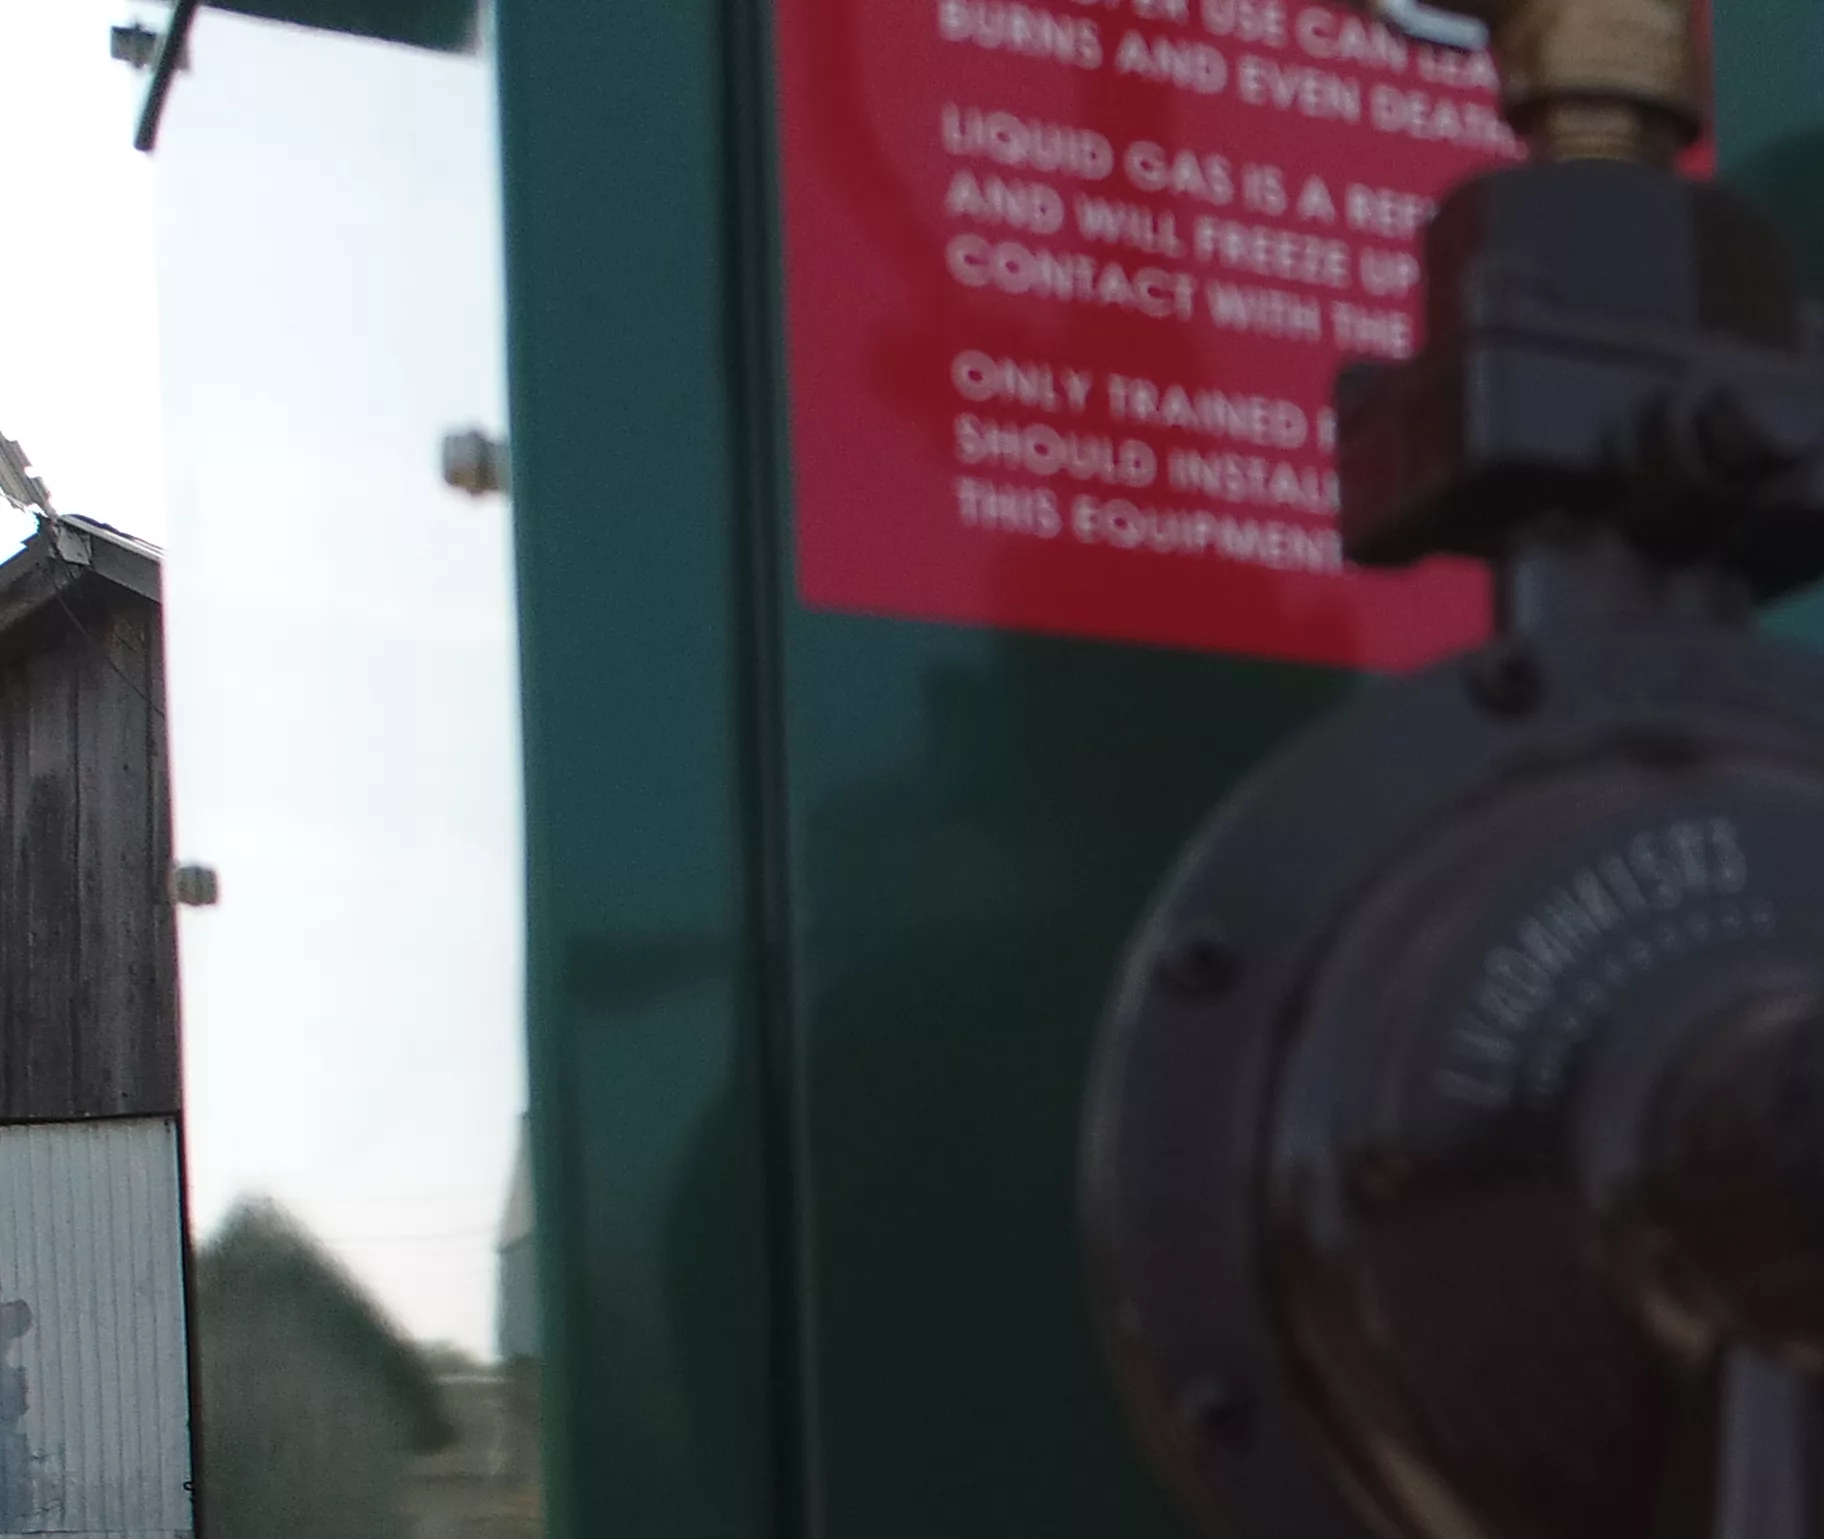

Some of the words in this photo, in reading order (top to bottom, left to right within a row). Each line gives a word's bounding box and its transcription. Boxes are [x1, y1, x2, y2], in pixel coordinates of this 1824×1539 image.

[937, 0, 1102, 70] BURNS
[1114, 28, 1227, 94] AND
[1236, 54, 1360, 122] EVEN
[1296, 8, 1404, 73] CAN
[1415, 42, 1500, 93] LEA
[941, 101, 1113, 181] LIQUID
[1124, 140, 1234, 206] GAS
[1241, 161, 1288, 217] IS
[1298, 174, 1336, 224] A
[946, 167, 1064, 234] AND
[1074, 192, 1185, 259] WILL
[1194, 214, 1351, 290] FREEZE
[944, 234, 1195, 322] CONTACT
[1207, 279, 1322, 342] WITH
[1330, 298, 1412, 360] THE
[951, 350, 1093, 413] ONLY
[1108, 373, 1307, 450] TRAINED
[954, 413, 1156, 488] SHOULD
[956, 476, 1061, 539] THIS
